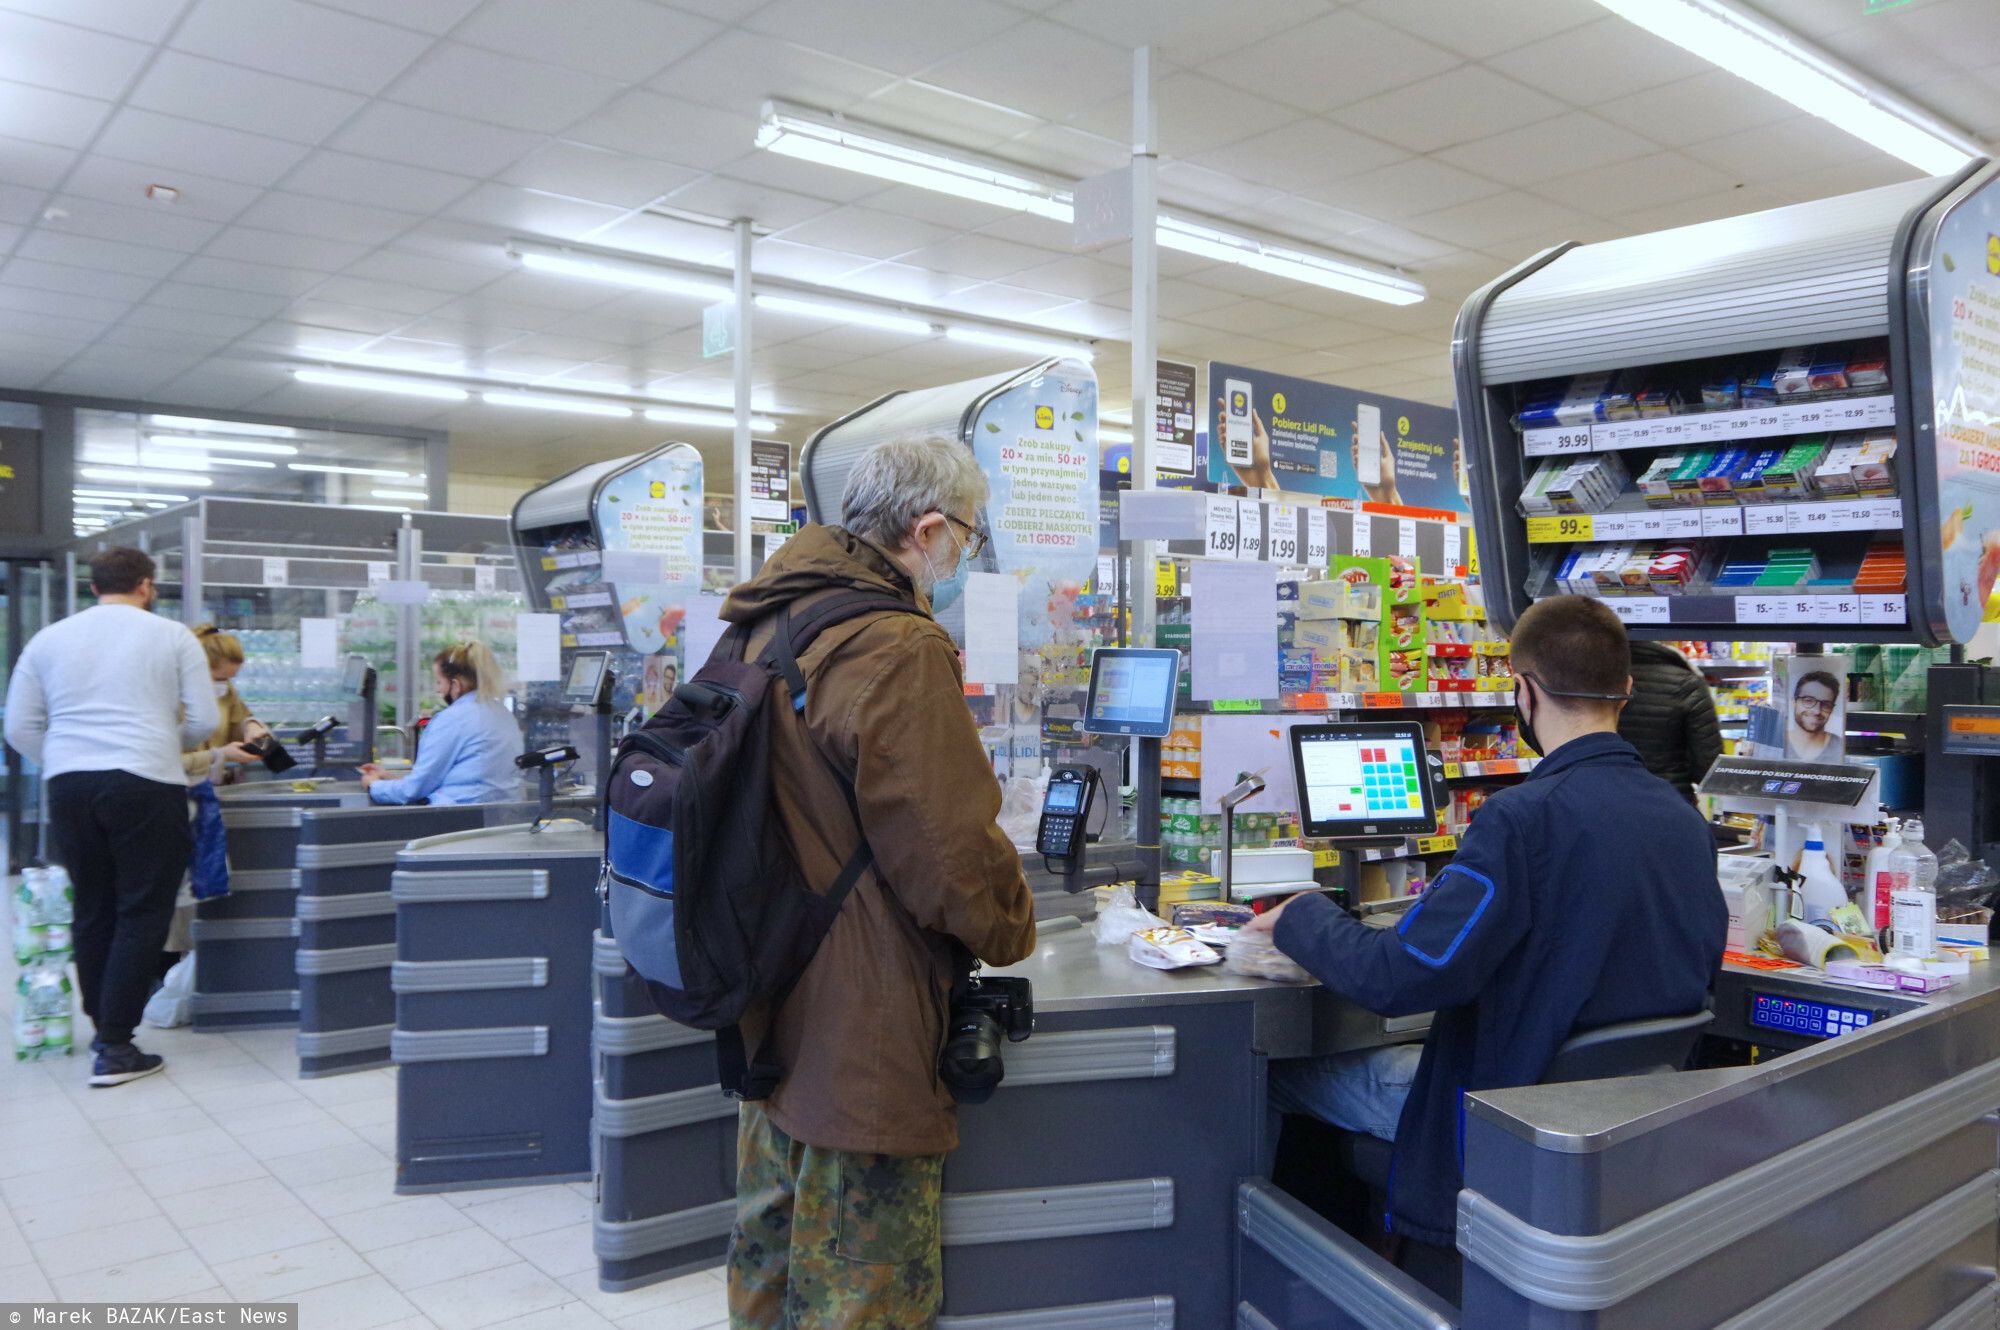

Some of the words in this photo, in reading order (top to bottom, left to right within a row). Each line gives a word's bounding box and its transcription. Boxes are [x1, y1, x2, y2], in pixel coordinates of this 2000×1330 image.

[1060, 382, 1083, 397] Disney
[1272, 416, 1301, 431] Pobierz
[1303, 421, 1317, 434] Lidl
[1318, 424, 1337, 437] Plus.
[1040, 441, 1071, 452] zakupy
[1558, 434, 1588, 449] 39.99
[1002, 448, 1014, 459] 20
[1037, 453, 1055, 463] min.
[1058, 454, 1070, 464] 50
[1012, 465, 1028, 474] tym
[1031, 467, 1087, 480] przynajmniej
[1013, 477, 1038, 488] jedno
[1040, 481, 1077, 491] warzywo
[1011, 490, 1026, 500] lub
[1028, 491, 1052, 502] jeden
[622, 512, 632, 520] 20
[668, 514, 678, 522] 50
[1005, 506, 1037, 517] ZBIERZ
[1039, 509, 1085, 521] PIECZĄTKI
[1004, 520, 1044, 531] ODBIERZ
[1046, 524, 1093, 536] MASKOTKĘ
[1560, 519, 1589, 535] 99.-
[1016, 534, 1028, 544] ZA
[1030, 534, 1034, 543] 1
[1036, 534, 1076, 545] GROSZ!
[1210, 531, 1236, 551] 1.89
[1243, 537, 1260, 551] 1.89
[1271, 539, 1295, 558] 1.99
[1309, 545, 1325, 557] 2.99
[1156, 584, 1174, 596] 3.99
[1756, 604, 1772, 613] 15.-
[1796, 603, 1814, 612] 15.-
[1838, 603, 1856, 612] 15.-
[1883, 602, 1902, 612] 15.-
[1015, 747, 1038, 758] LIDL
[1715, 767, 1761, 776] ZAPRASZAMY
[1775, 771, 1793, 779] KASY
[1794, 773, 1869, 784] SAMOOBSŁUGOWEJ
[1326, 851, 1338, 861] 1.99
